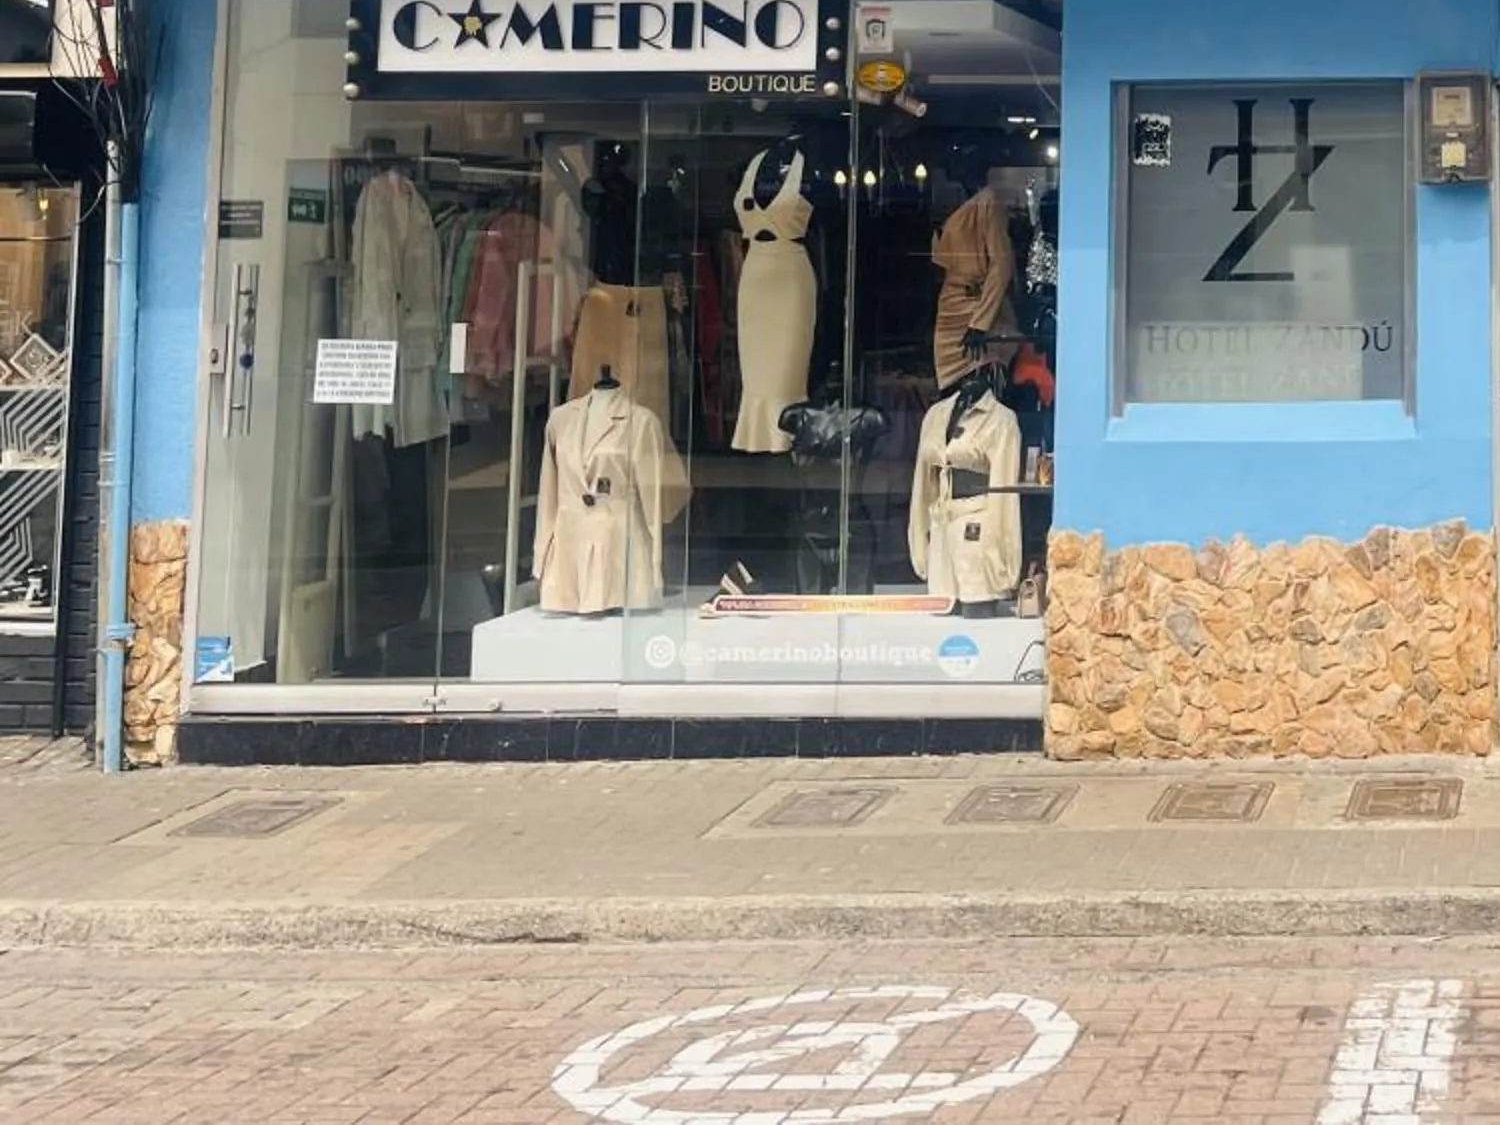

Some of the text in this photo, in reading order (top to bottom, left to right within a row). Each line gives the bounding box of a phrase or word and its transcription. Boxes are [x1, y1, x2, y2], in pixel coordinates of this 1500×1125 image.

[708, 75, 816, 94] BOUTIQUE
[1144, 319, 1395, 355] HOTEL ZANDÚ
[679, 639, 934, 667] @camerinoboutique
